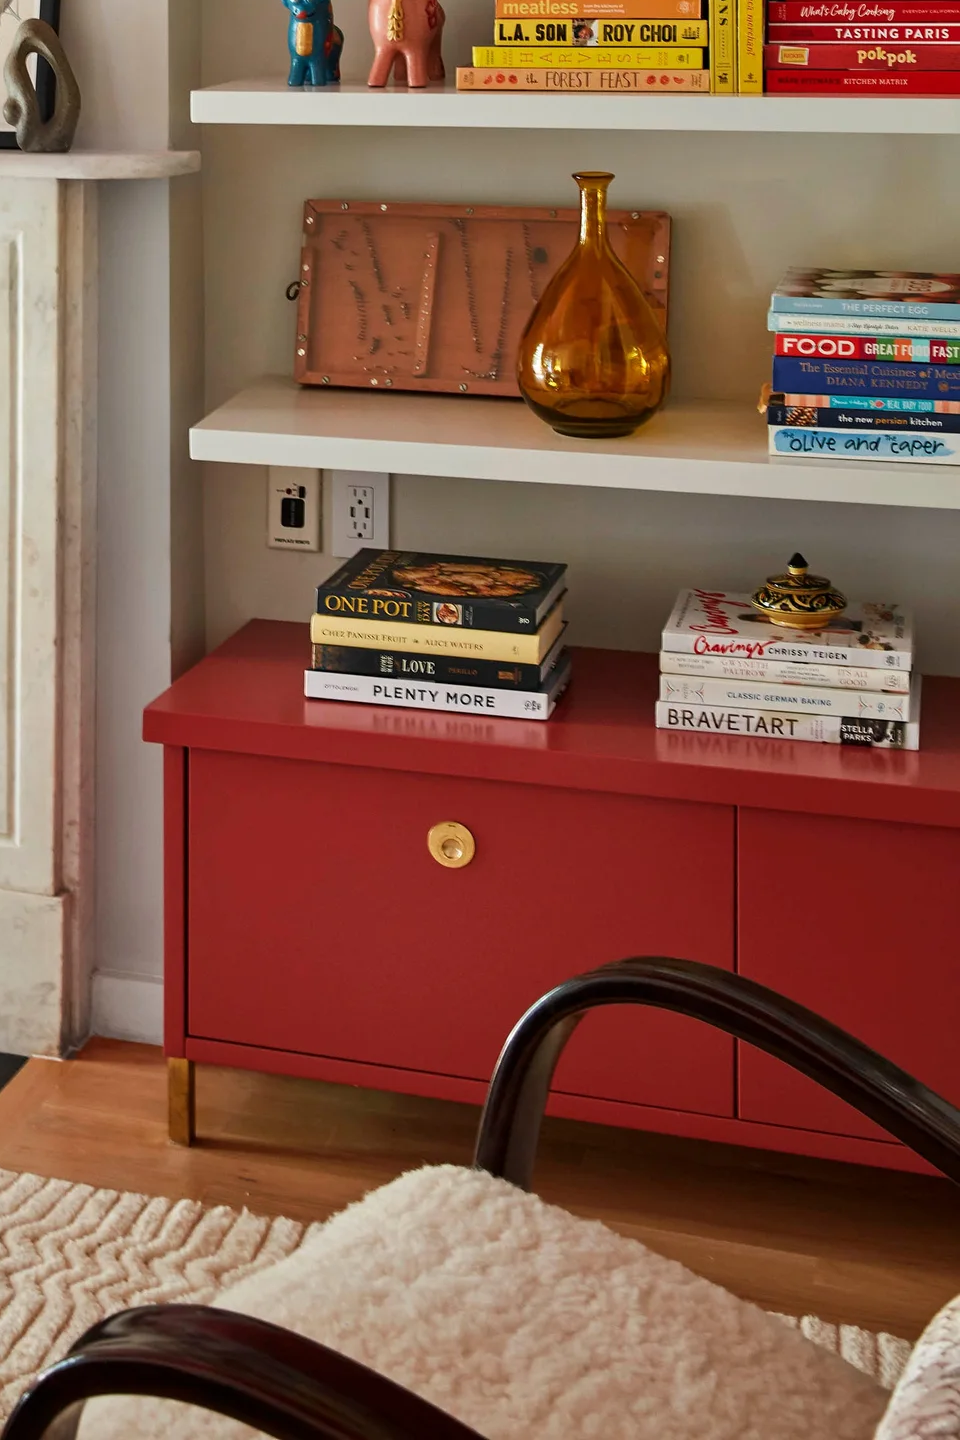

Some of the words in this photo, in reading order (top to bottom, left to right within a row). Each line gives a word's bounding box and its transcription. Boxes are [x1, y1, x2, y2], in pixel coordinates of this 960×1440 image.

[503, 0, 579, 15] meatless
[499, 24, 530, 42] L.A.
[535, 24, 567, 42] SON
[603, 24, 635, 42] ROY
[640, 24, 677, 43] CHOI
[835, 28, 900, 39] TASTING
[905, 28, 950, 39] PARIS
[526, 73, 539, 84] the
[545, 71, 593, 88] FOREST
[600, 71, 640, 88] FEAST
[879, 78, 908, 86] MATRIX
[842, 303, 860, 312] THE
[862, 304, 906, 314] PERFECT
[908, 306, 929, 315] EGG
[783, 337, 856, 356] FOOD
[864, 343, 900, 355] GREAT
[901, 344, 930, 357] FOOD
[932, 345, 960, 358] FAST
[799, 362, 820, 373] The
[823, 363, 868, 375] Essential
[871, 365, 917, 377] Cuisines
[919, 367, 933, 378] of
[826, 376, 866, 387] DIANA
[871, 378, 929, 390] KENNEDY
[838, 414, 853, 423] the
[875, 417, 908, 426] persian
[910, 417, 943, 427] kitchen
[325, 594, 369, 614] ONE
[372, 599, 413, 618] POT
[322, 629, 344, 638] CHEZ
[347, 630, 381, 641] PANISSE
[381, 634, 407, 644] FRUIT
[425, 639, 449, 648] ALICE
[450, 642, 484, 651] WATERS
[693, 635, 777, 658] Cravings
[768, 647, 810, 658] CHRISSY
[813, 651, 848, 661] TEIGEN
[401, 658, 436, 675] LOVE
[373, 685, 439, 703] PLENTY
[447, 692, 496, 708] MORE
[726, 691, 762, 701] CLASSIC
[764, 695, 798, 704] GERMAN
[801, 698, 832, 707] BAKING
[667, 708, 799, 736] BRAVETART
[840, 724, 874, 735] STELLA
[844, 734, 872, 742] PARKS
